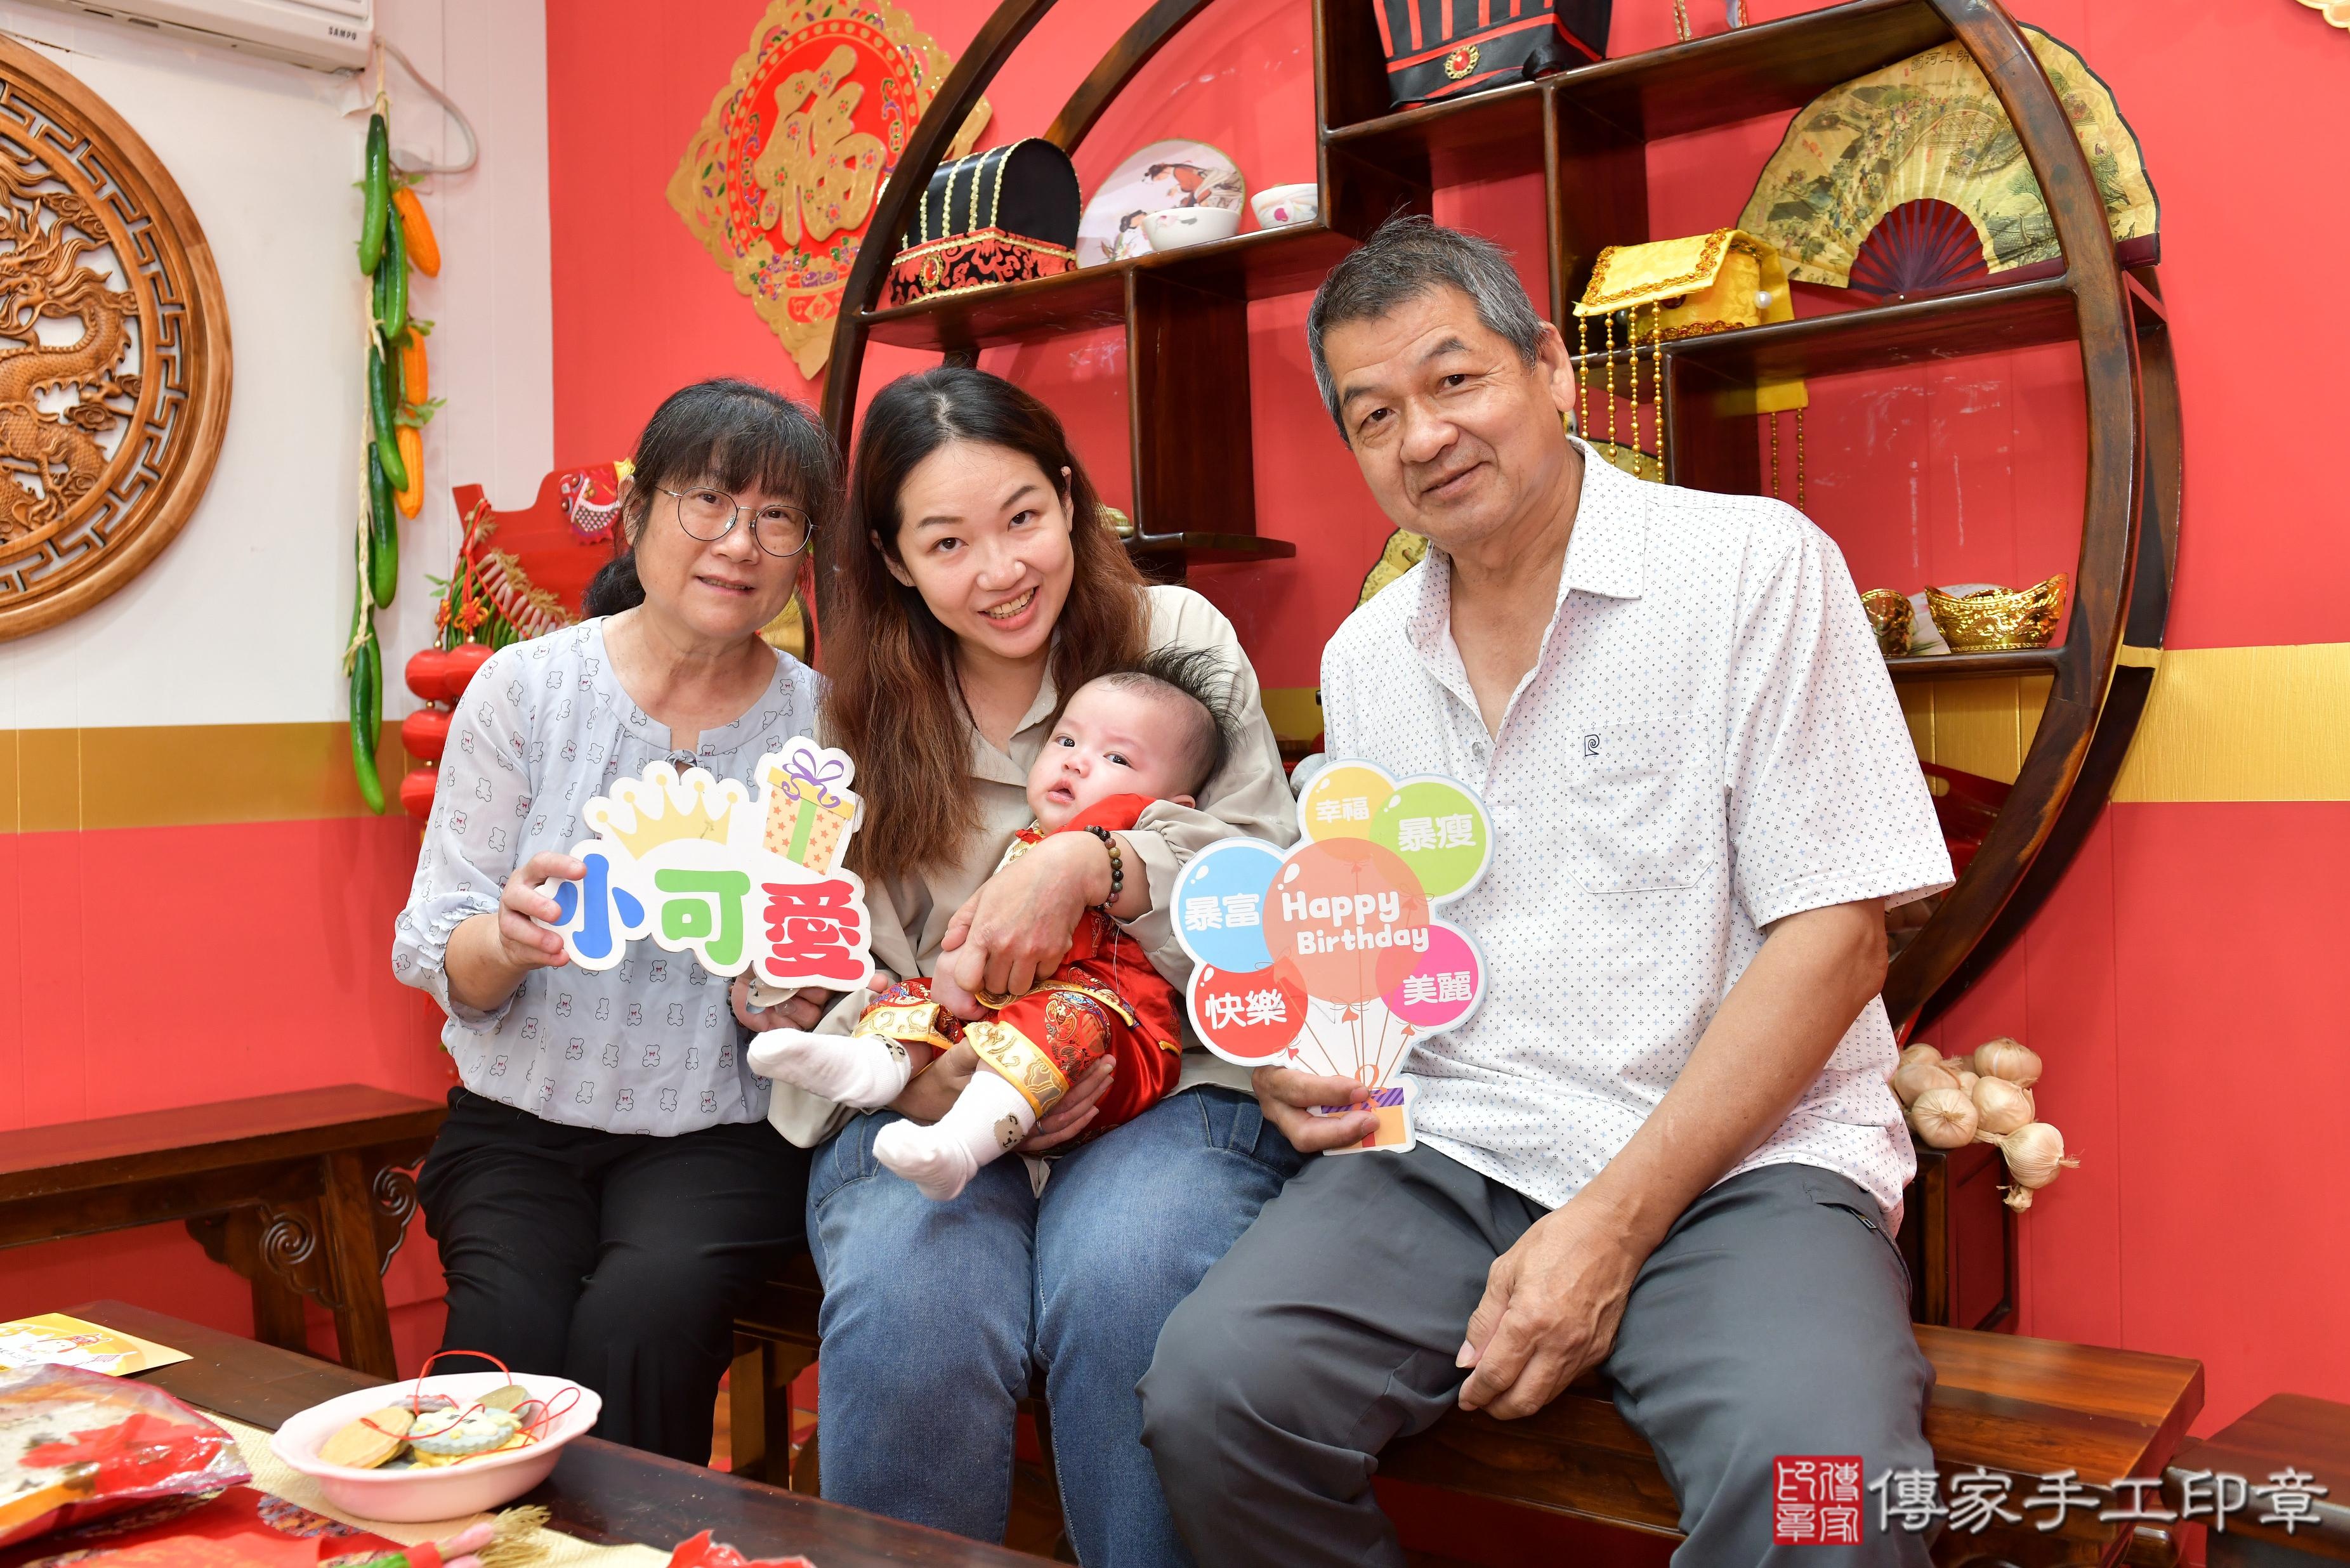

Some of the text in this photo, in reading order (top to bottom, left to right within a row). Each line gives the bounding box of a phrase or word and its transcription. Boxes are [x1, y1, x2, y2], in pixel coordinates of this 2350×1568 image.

[328, 25, 357, 41] SAMPO
[1911, 49, 1976, 71] 明上河圖
[754, 44, 887, 246] 福
[1315, 797, 1370, 824] 幸福
[1397, 813, 1476, 852] 暴瘦
[549, 853, 865, 981] 小可愛
[1184, 893, 1260, 931] 暴富
[1282, 891, 1400, 927] Happy
[1297, 924, 1430, 955] Birthday
[1402, 971, 1473, 1007] 美麗
[1204, 988, 1287, 1029] 快樂
